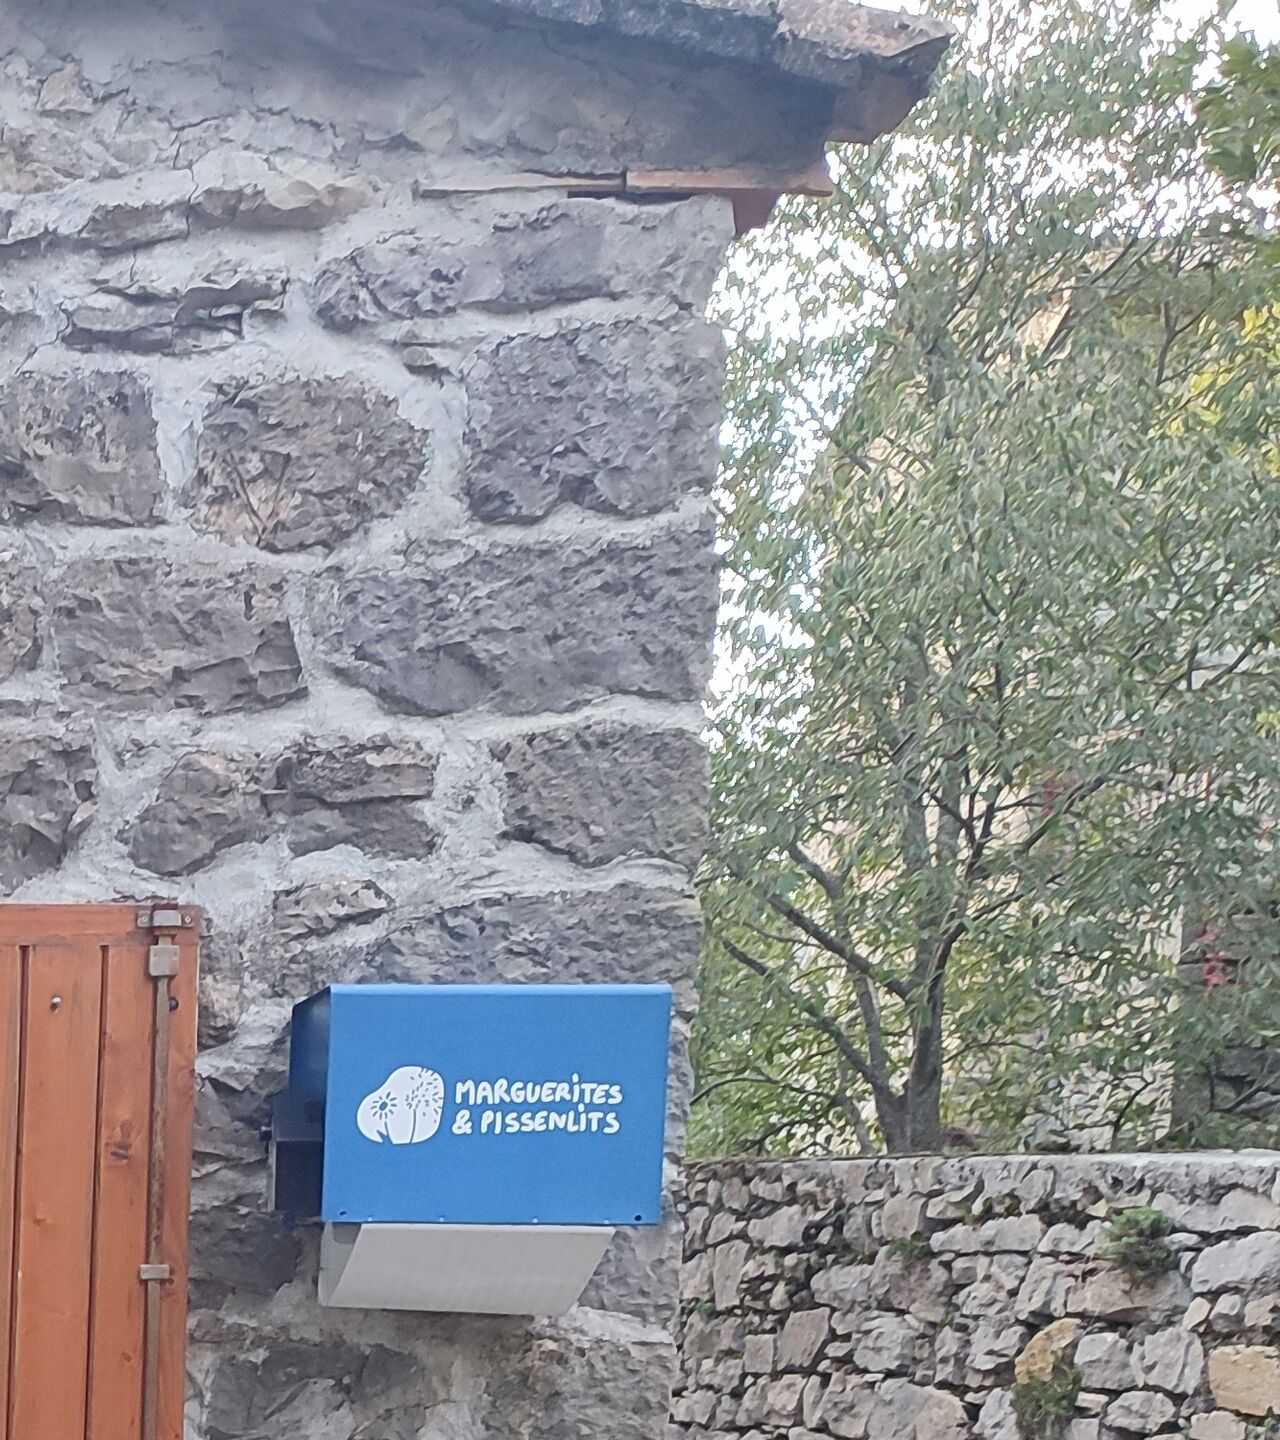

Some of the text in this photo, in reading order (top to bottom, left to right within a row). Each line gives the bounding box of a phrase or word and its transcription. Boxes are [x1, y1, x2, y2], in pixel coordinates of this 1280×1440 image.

[455, 1072, 623, 1105] MARGUERiTES
[452, 1103, 620, 1134] & PISSENLiTS
